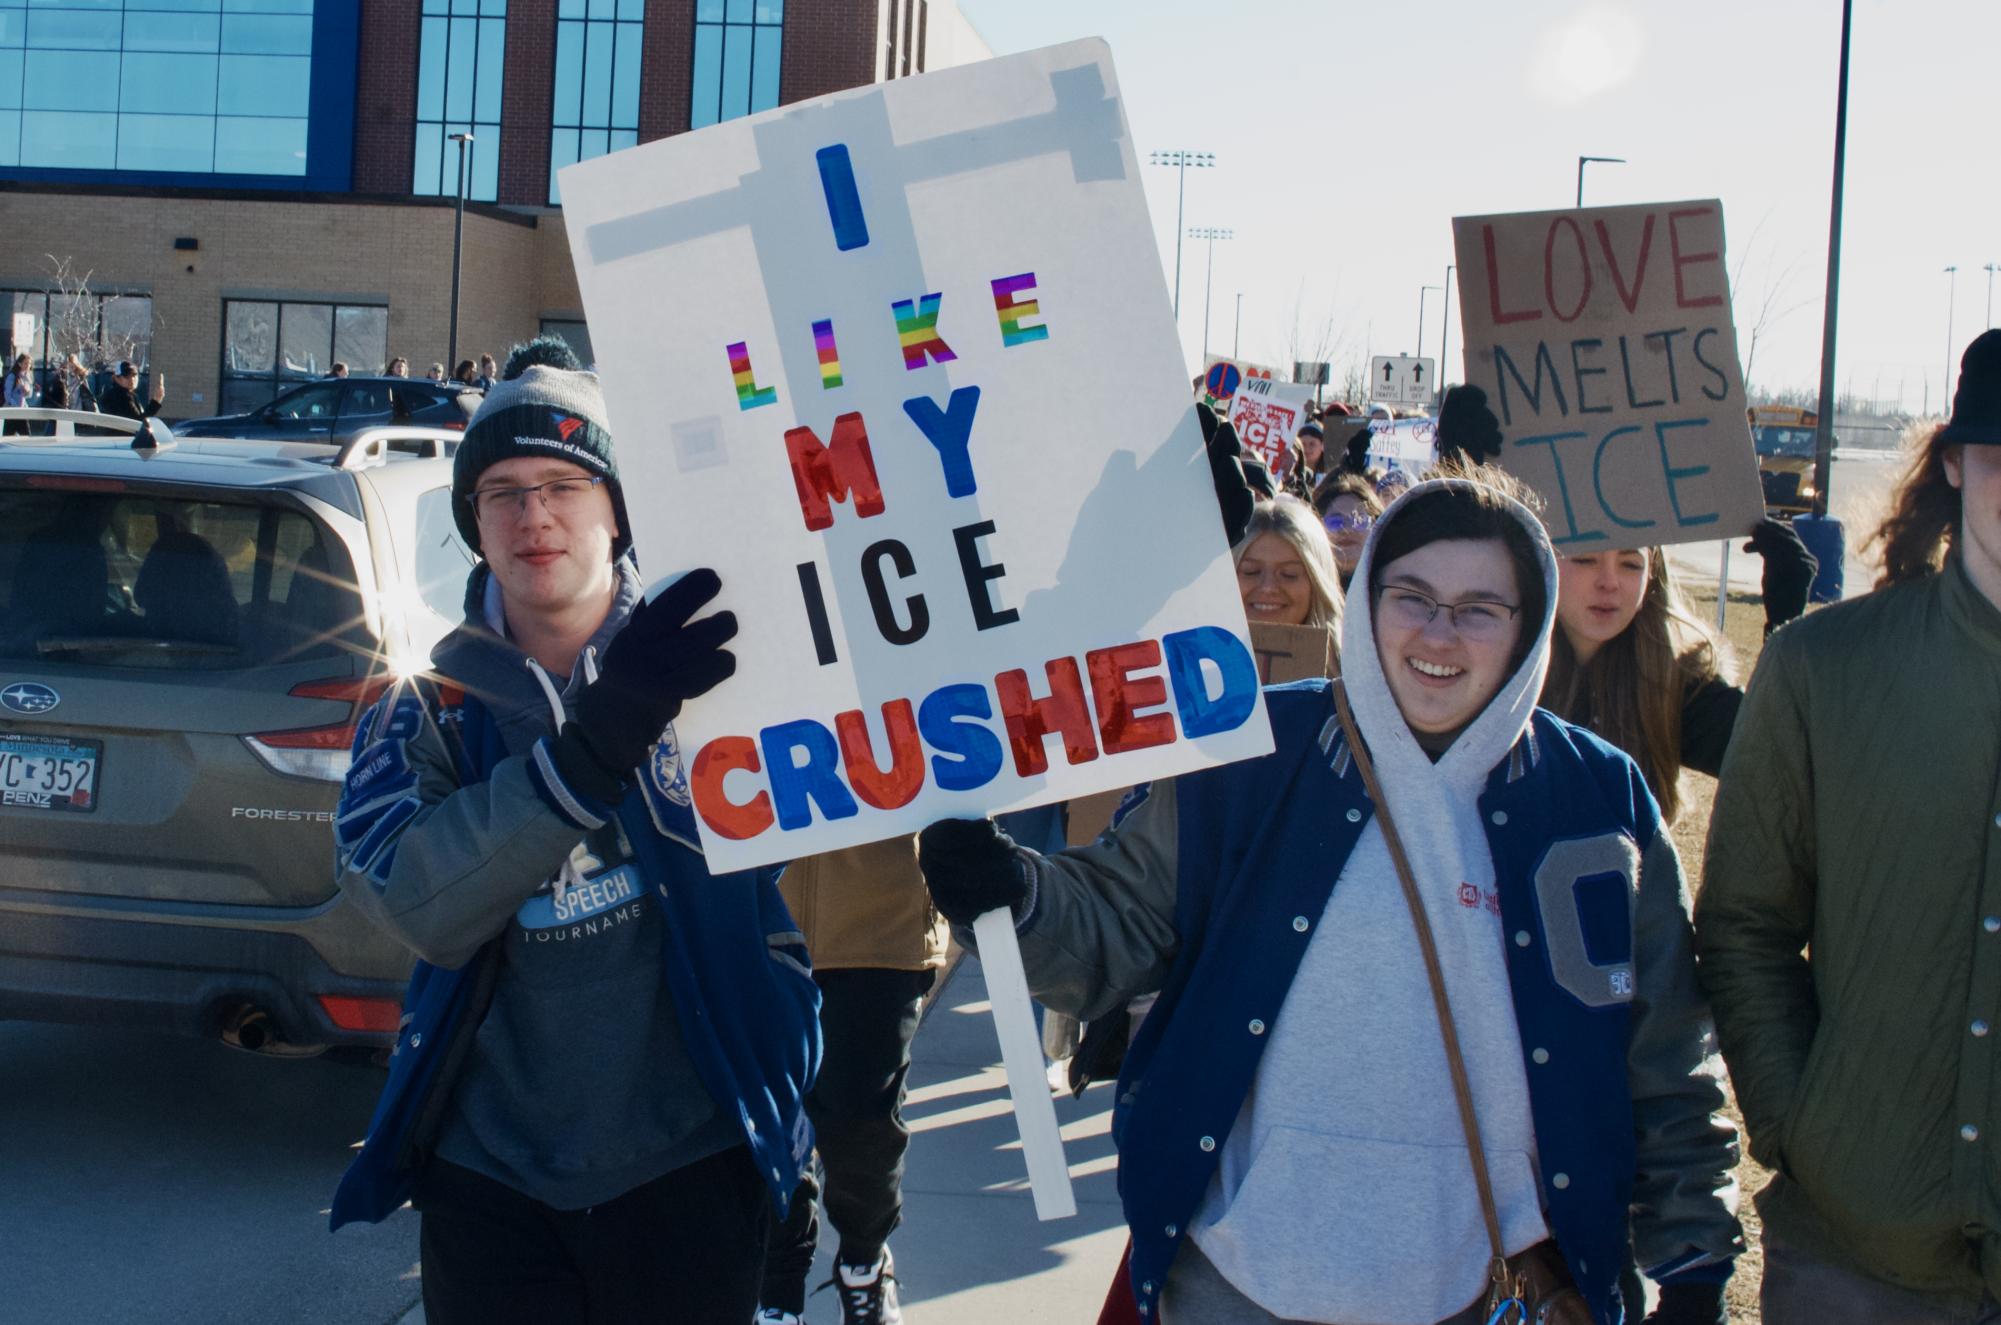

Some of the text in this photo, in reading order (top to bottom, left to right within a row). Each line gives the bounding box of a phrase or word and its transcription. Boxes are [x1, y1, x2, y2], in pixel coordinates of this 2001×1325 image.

[816, 143, 870, 251] I
[1483, 207, 1723, 325] LOVE
[726, 272, 1049, 411] LIKE
[1494, 327, 1729, 426] MELTS
[1237, 418, 1282, 449] ICE
[1375, 391, 1399, 399] TRAFFIC
[514, 436, 608, 468] Volunteers of America
[784, 385, 980, 532] MY
[1514, 418, 1719, 544] ICE
[797, 519, 1020, 666] ICE
[41, 757, 91, 796] 352
[350, 751, 393, 791] HORN LINE
[690, 625, 1259, 840] CRUSHED
[3, 790, 52, 805] PENZ
[554, 871, 631, 920] SPEECH
